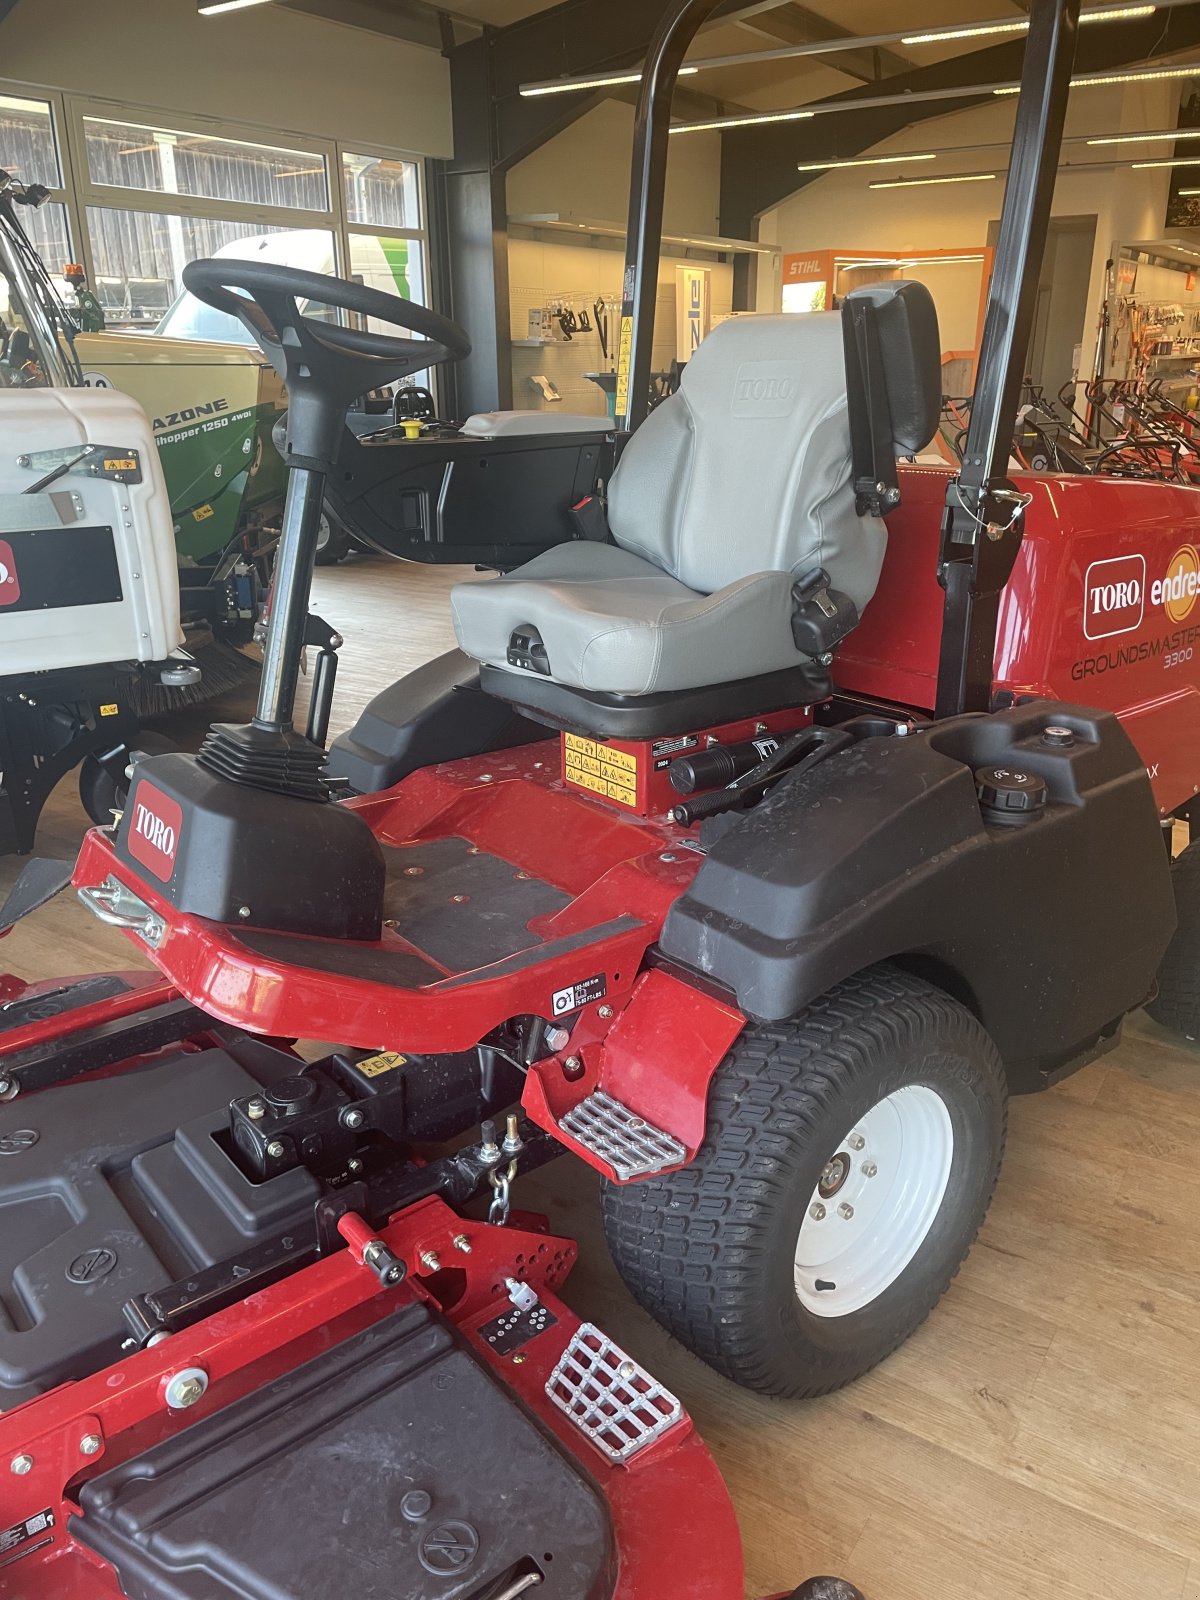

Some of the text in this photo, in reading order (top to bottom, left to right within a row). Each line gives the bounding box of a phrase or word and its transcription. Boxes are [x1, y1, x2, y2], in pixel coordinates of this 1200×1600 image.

[789, 260, 820, 275] STIHL
[201, 417, 228, 433] 1250
[1090, 579, 1140, 615] TORO
[1163, 647, 1193, 669] 3300
[135, 803, 175, 856] TORO
